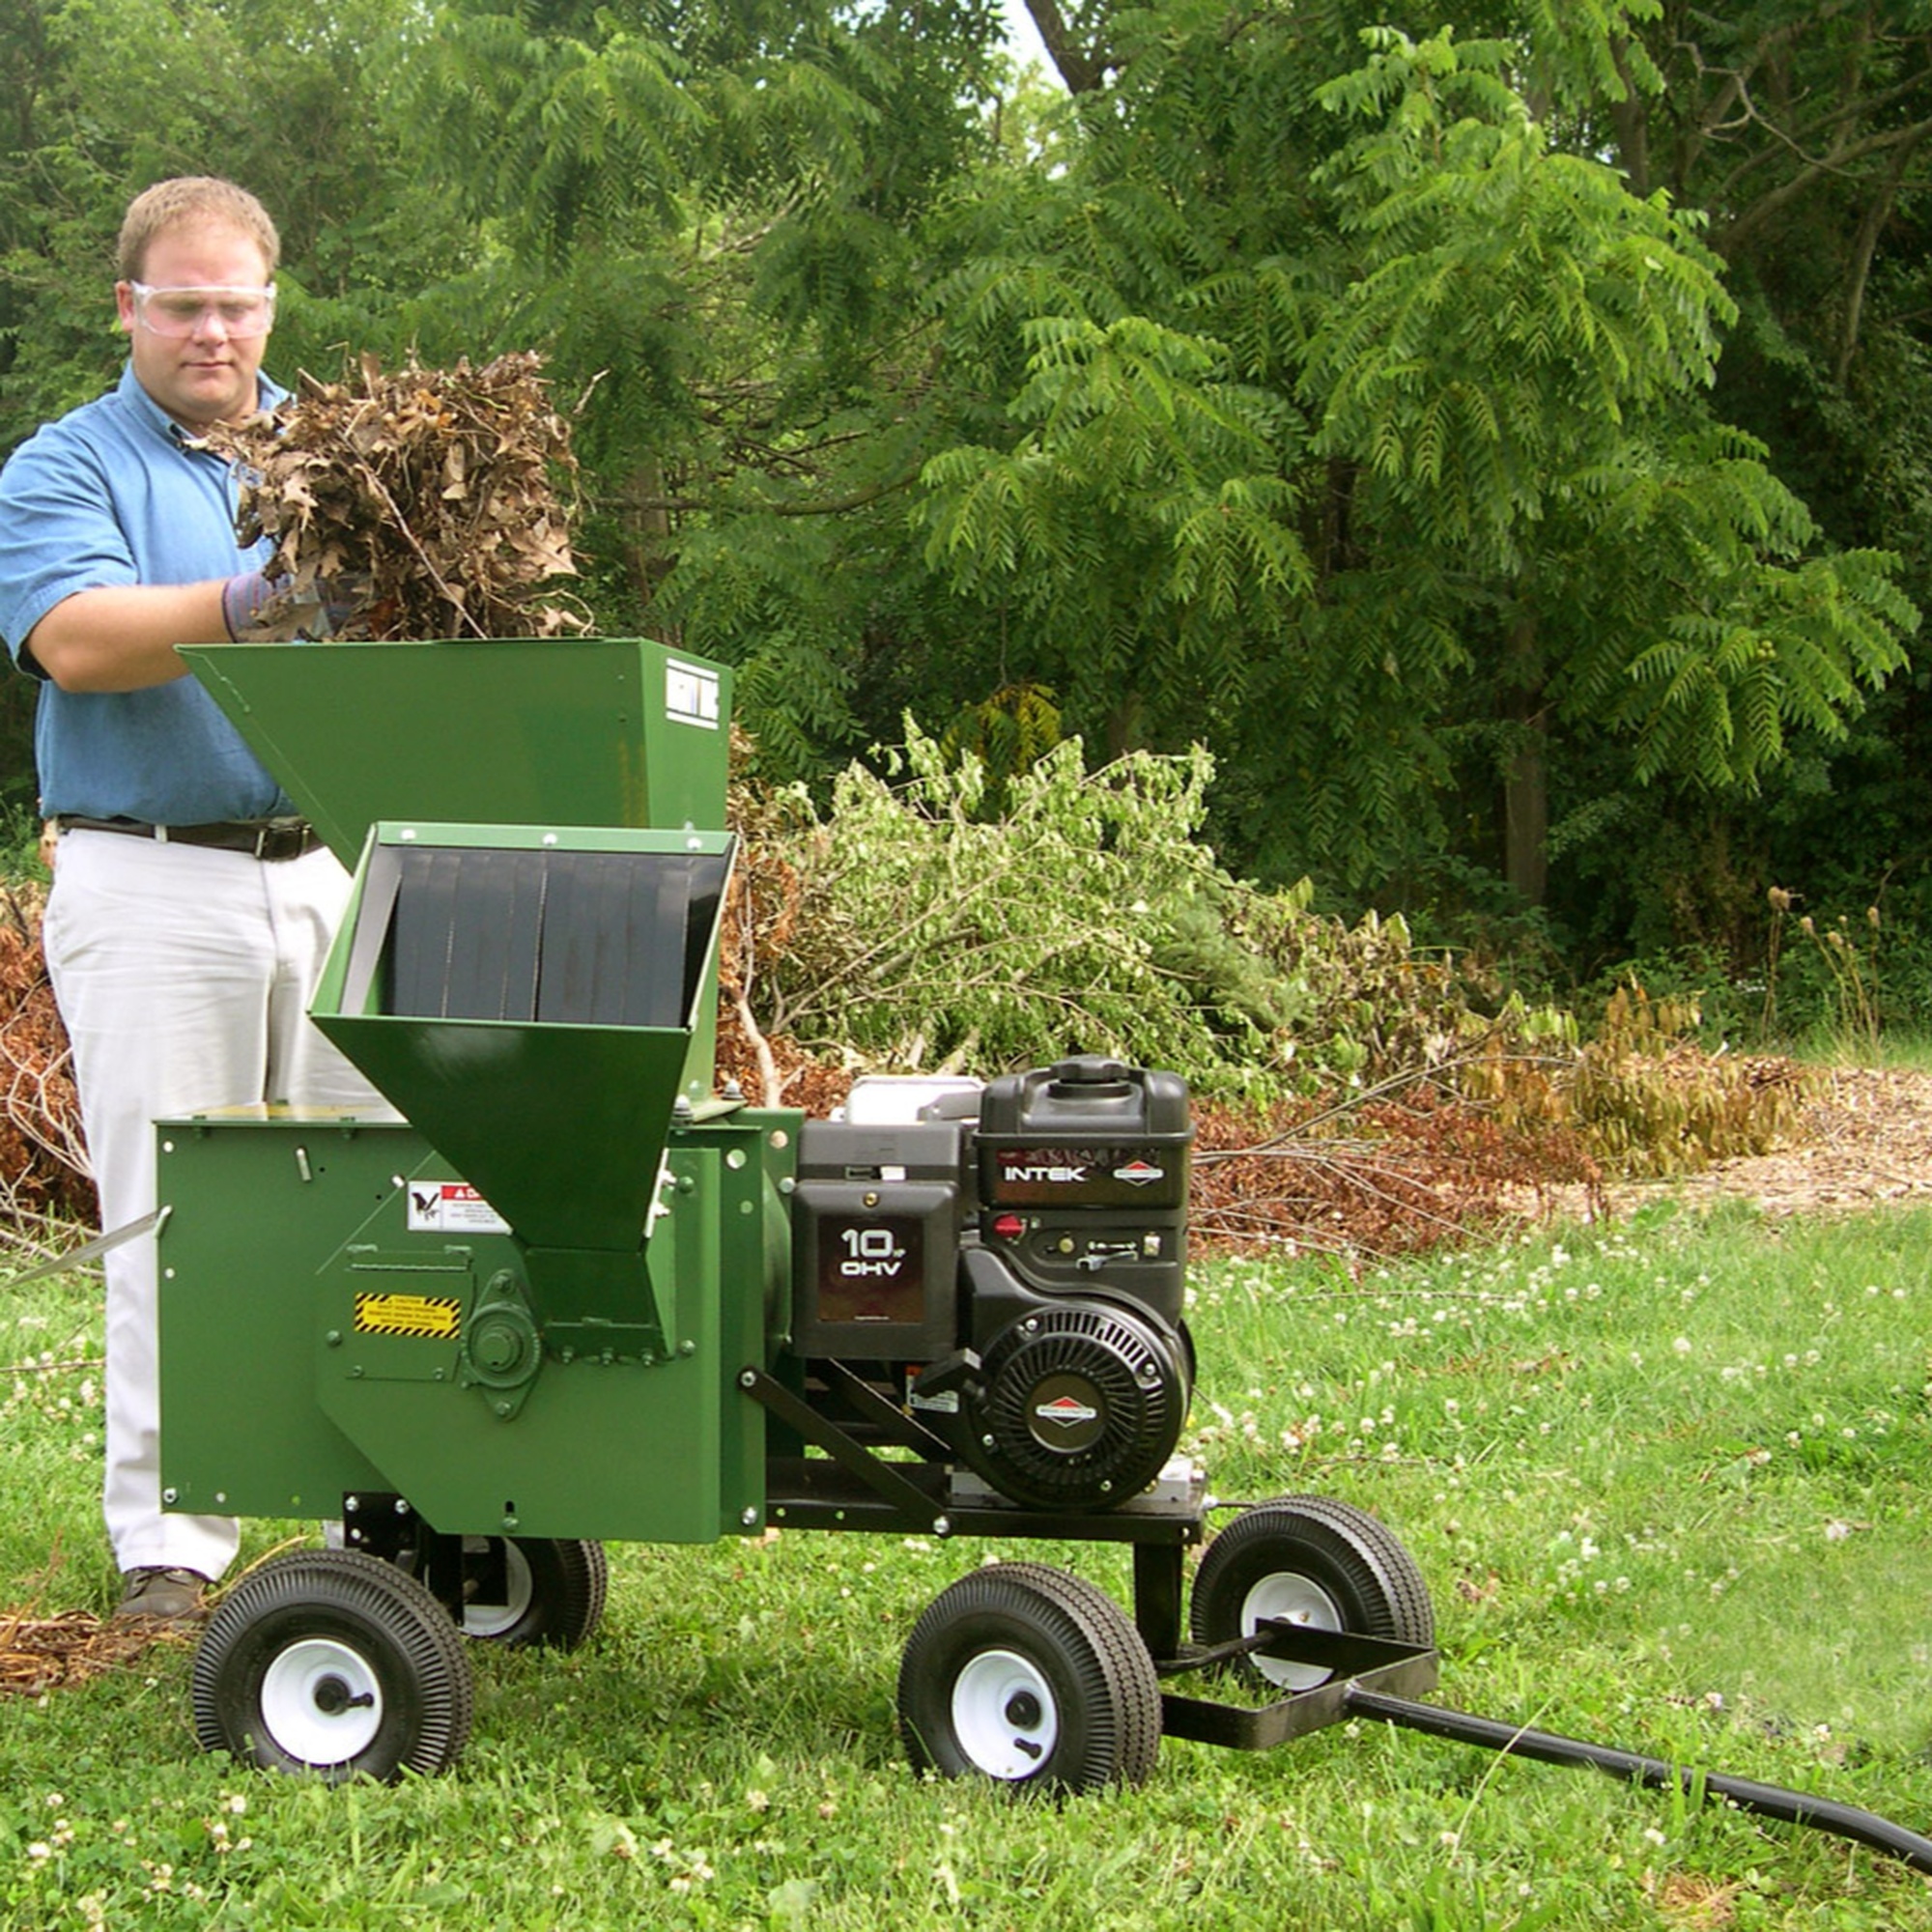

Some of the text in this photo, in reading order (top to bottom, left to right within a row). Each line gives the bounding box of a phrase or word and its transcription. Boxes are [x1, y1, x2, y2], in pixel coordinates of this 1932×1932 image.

[1005, 1166, 1087, 1181] INTEK
[841, 1229, 894, 1257] 10
[840, 1262, 901, 1275] OHV
